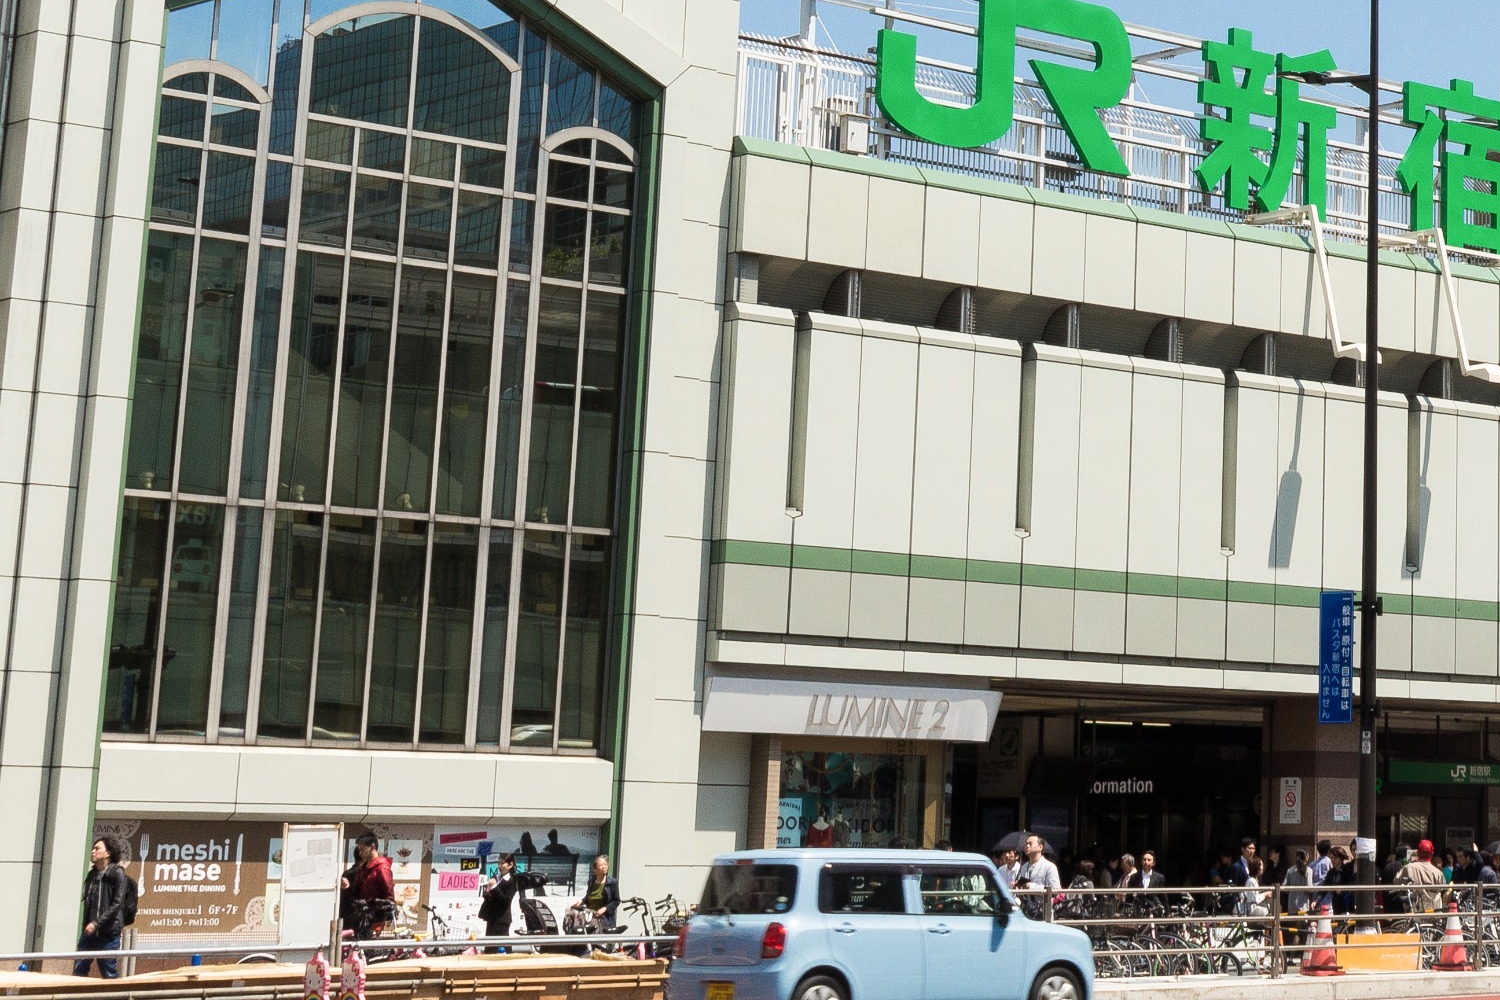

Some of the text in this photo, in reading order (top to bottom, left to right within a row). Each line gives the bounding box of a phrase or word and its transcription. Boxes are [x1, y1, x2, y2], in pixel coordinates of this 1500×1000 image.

[1331, 618, 1341, 697] バスタ新宿へは
[1341, 597, 1351, 711] 一般車・原付・自転車は
[1321, 663, 1331, 720] 入れません
[807, 693, 950, 731] LUMINE 2
[1451, 764, 1467, 778] JR
[1470, 765, 1491, 777] 新宿駅
[1089, 777, 1153, 794] ormation
[156, 838, 231, 861] meshi
[154, 863, 222, 881] mase
[462, 861, 477, 870] For
[153, 884, 226, 893] LUMINE THE DINING
[441, 874, 478, 889] LADIES'
[150, 918, 183, 927] AM11:00
[188, 917, 220, 926] PM11:00
